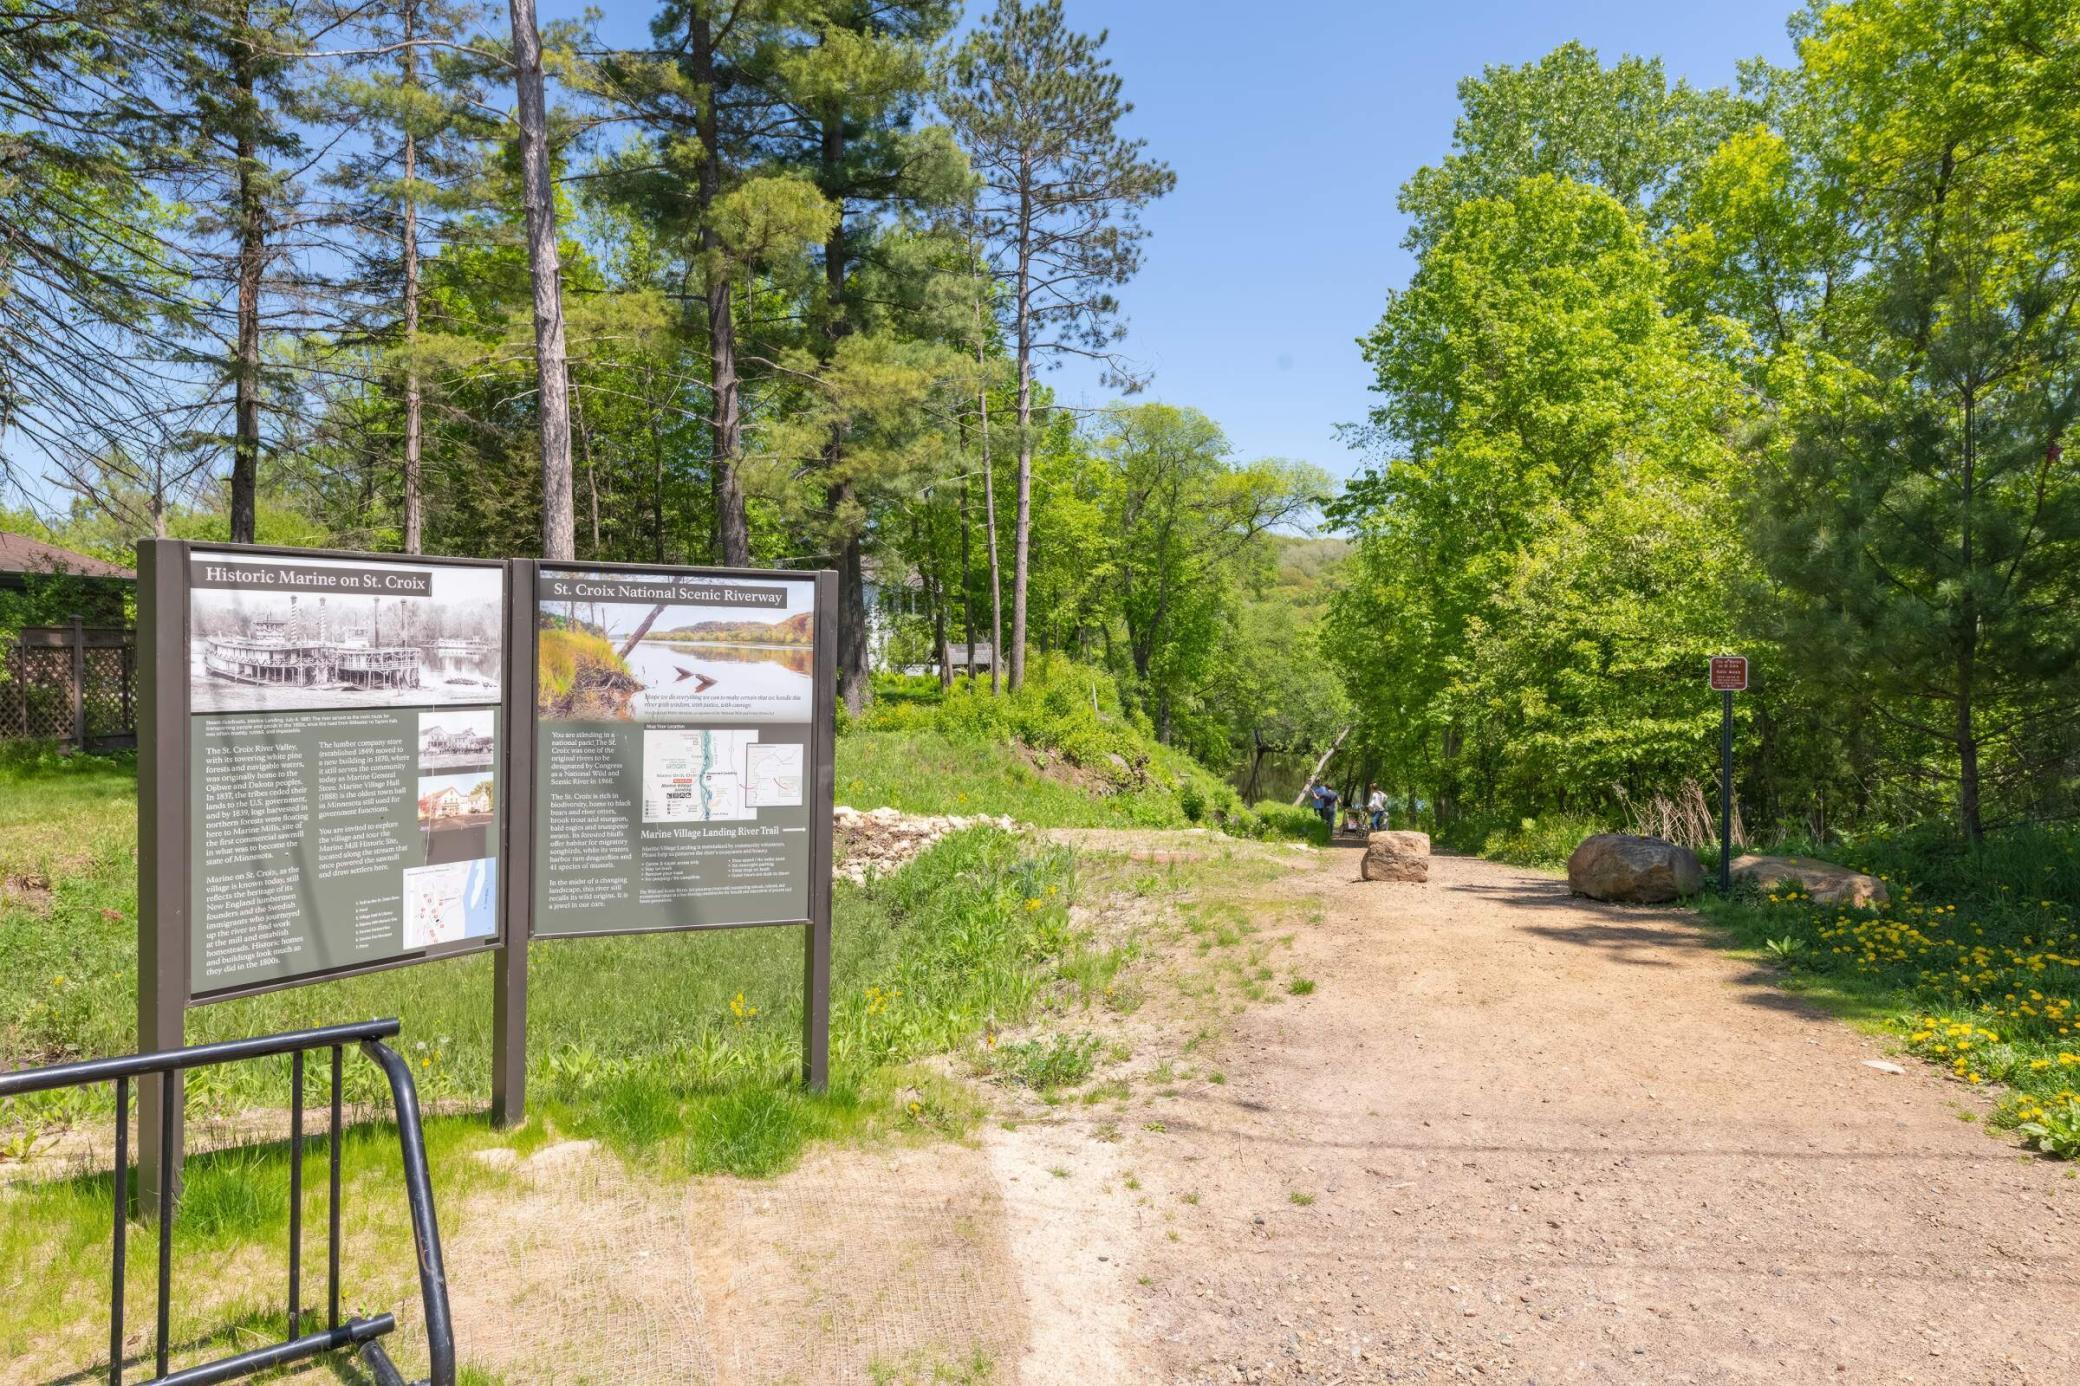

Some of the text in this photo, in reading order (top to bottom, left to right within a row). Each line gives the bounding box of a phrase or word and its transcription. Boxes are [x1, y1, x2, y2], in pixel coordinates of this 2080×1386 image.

[206, 567, 426, 590] Historic Marine on St. Croix
[554, 583, 783, 605] St. Croix National Scenic Riverway
[640, 826, 779, 839] Marine Village Landing River Trail
